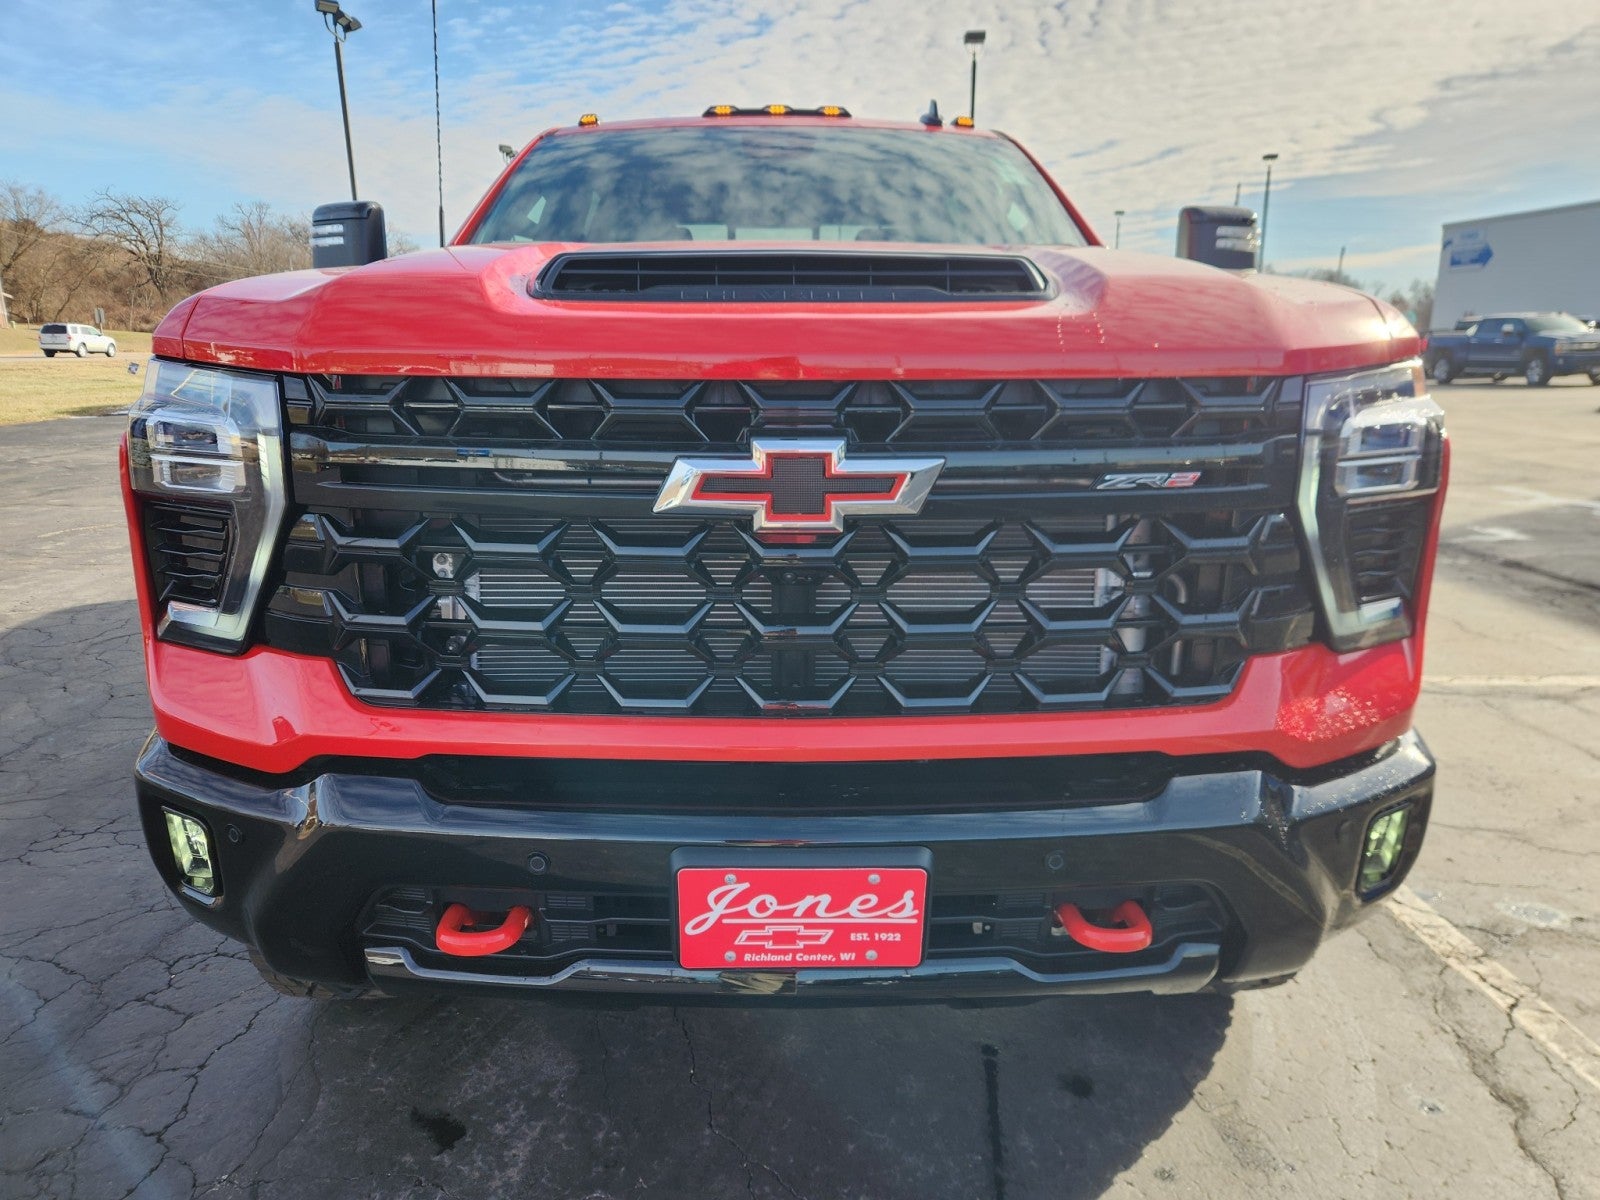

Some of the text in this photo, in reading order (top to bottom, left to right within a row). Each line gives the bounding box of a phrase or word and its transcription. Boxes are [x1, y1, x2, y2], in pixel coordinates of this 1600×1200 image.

[1096, 471, 1201, 490] ZR2
[684, 881, 919, 936] Jones
[850, 932, 902, 942] EST. 1922
[743, 952, 856, 963] Richland Center, WI
